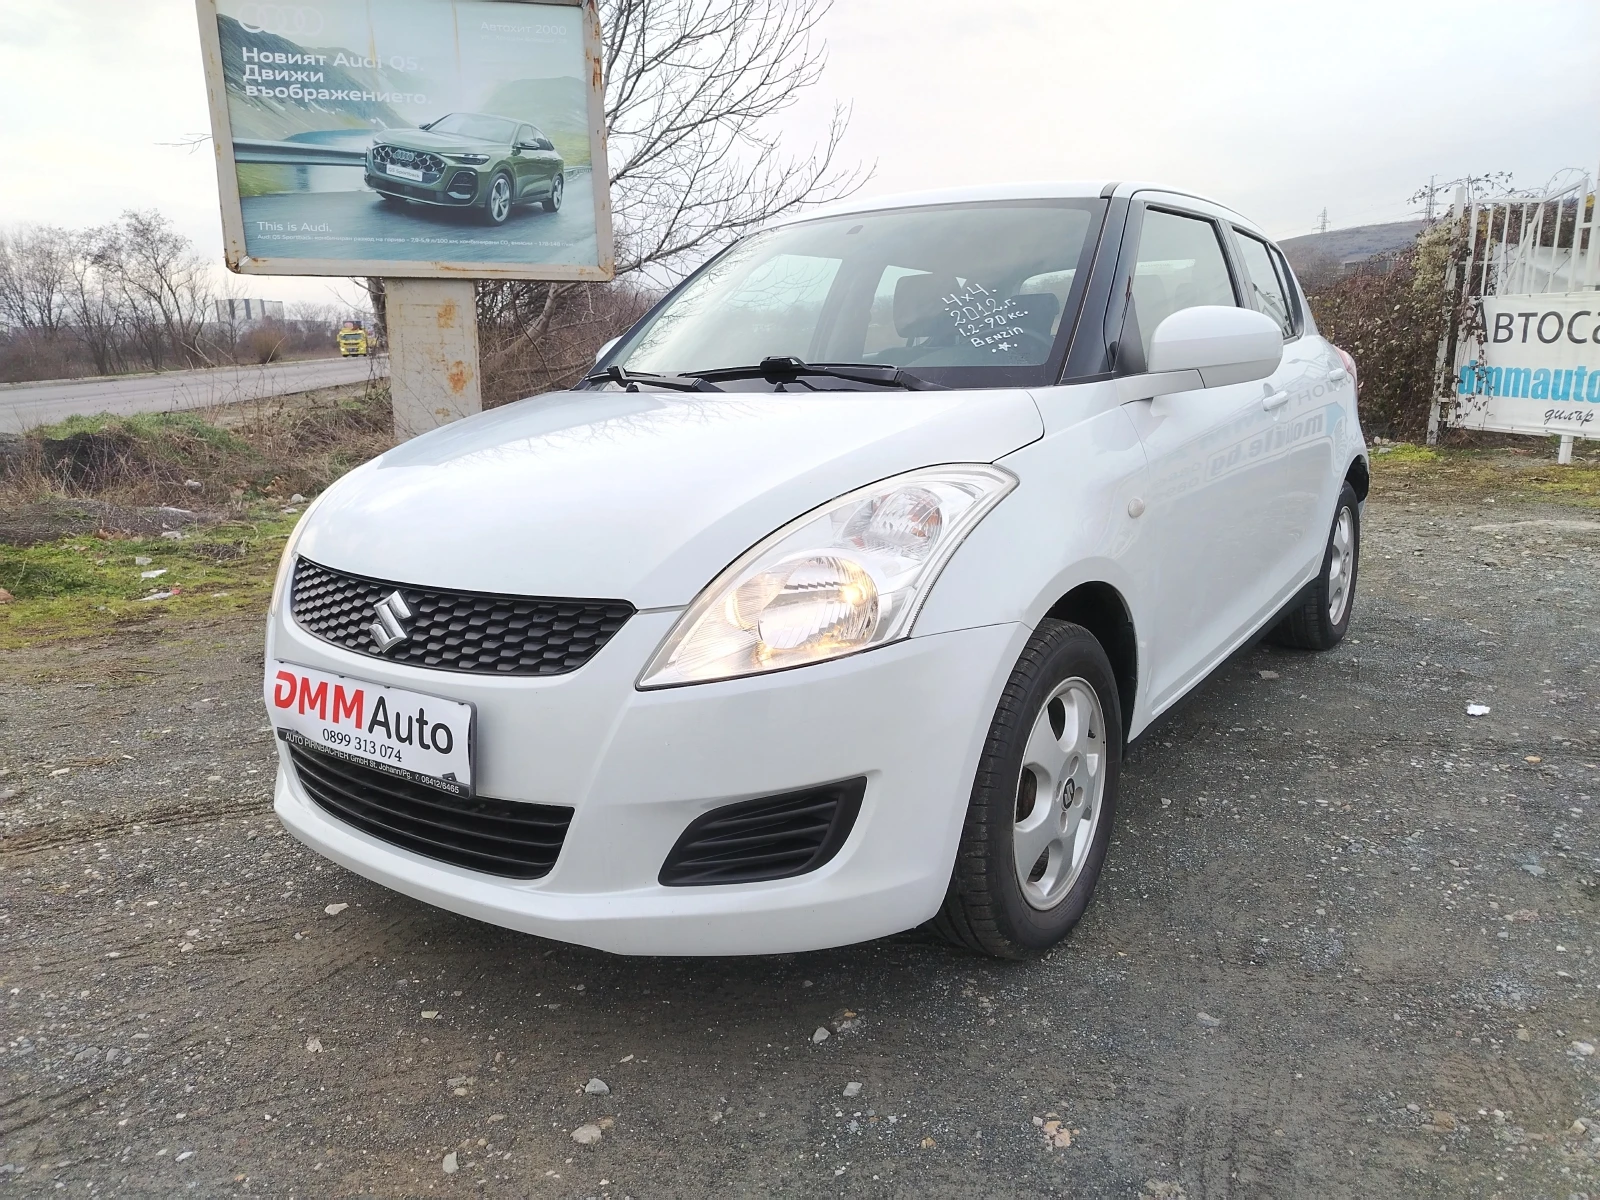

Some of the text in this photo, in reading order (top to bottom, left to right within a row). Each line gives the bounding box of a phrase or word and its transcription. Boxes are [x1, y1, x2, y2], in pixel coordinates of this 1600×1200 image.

[480, 21, 567, 36] Автохит 2000
[242, 46, 425, 73] Новият Audi Q5.
[242, 64, 324, 83] Движи
[245, 84, 432, 105] въображението.
[256, 221, 332, 232] This is Audi.
[1544, 408, 1595, 427] дилър
[322, 728, 403, 763] 0899 313 074
[285, 732, 304, 746] AUTO
[304, 734, 349, 760] PIRNBACHER
[350, 753, 369, 767] GmbH
[369, 759, 378, 769] St.
[379, 761, 413, 780] Johann/Pg.
